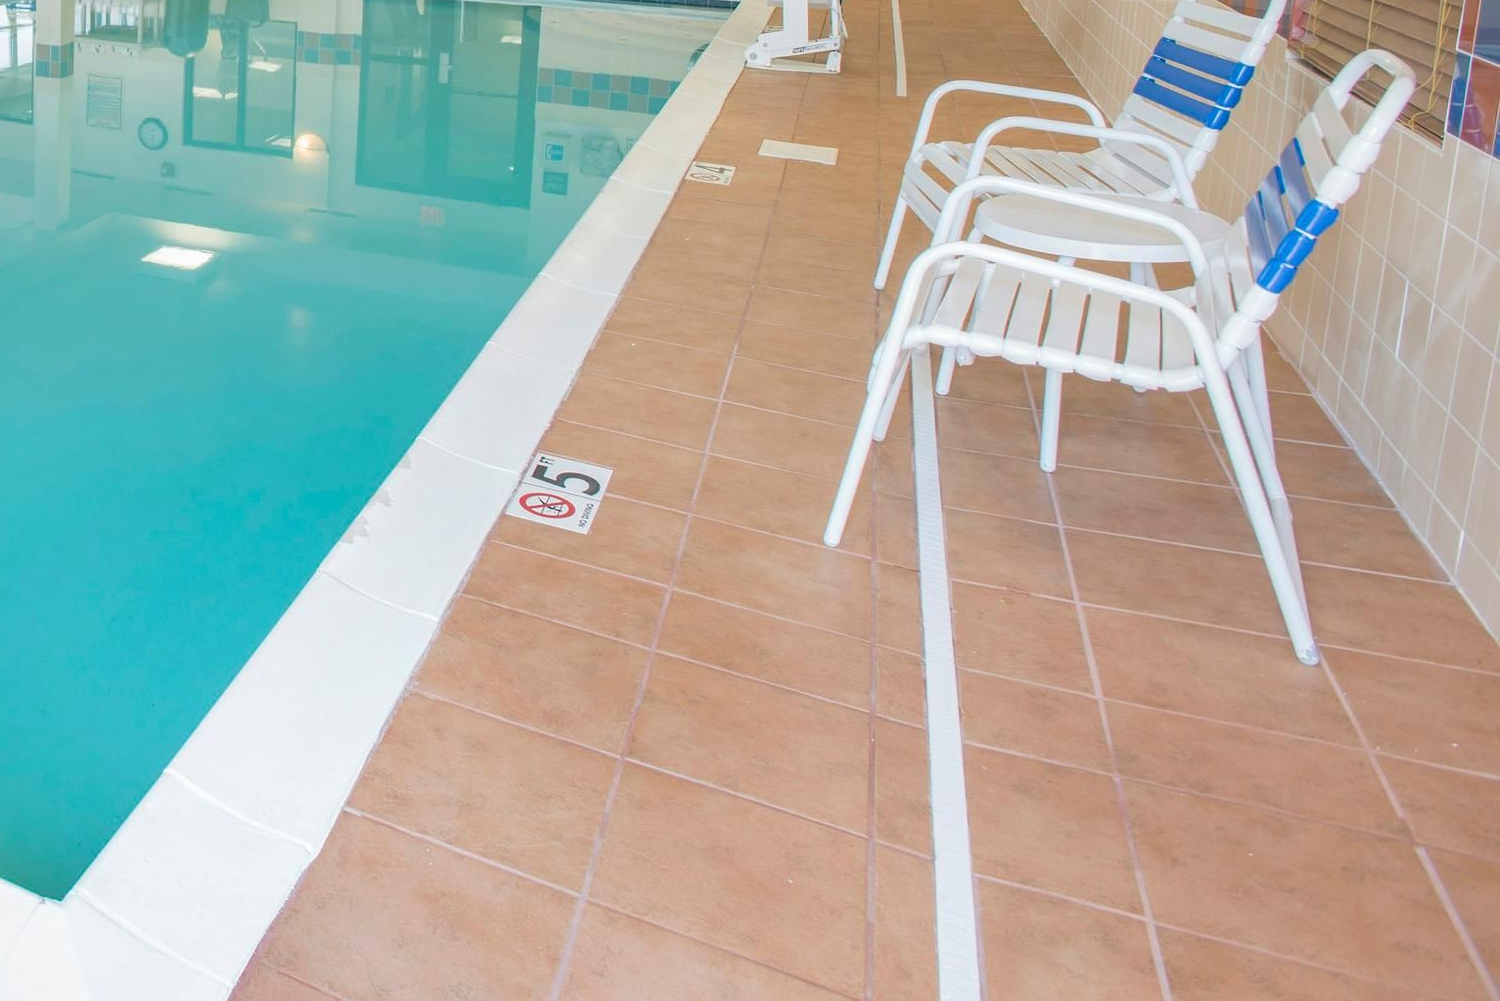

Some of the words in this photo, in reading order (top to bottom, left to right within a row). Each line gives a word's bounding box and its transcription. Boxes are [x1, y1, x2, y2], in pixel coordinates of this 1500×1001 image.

[540, 456, 555, 465] FT
[532, 464, 601, 496] 5
[581, 503, 594, 520] DIVING
[578, 519, 587, 527] NO
